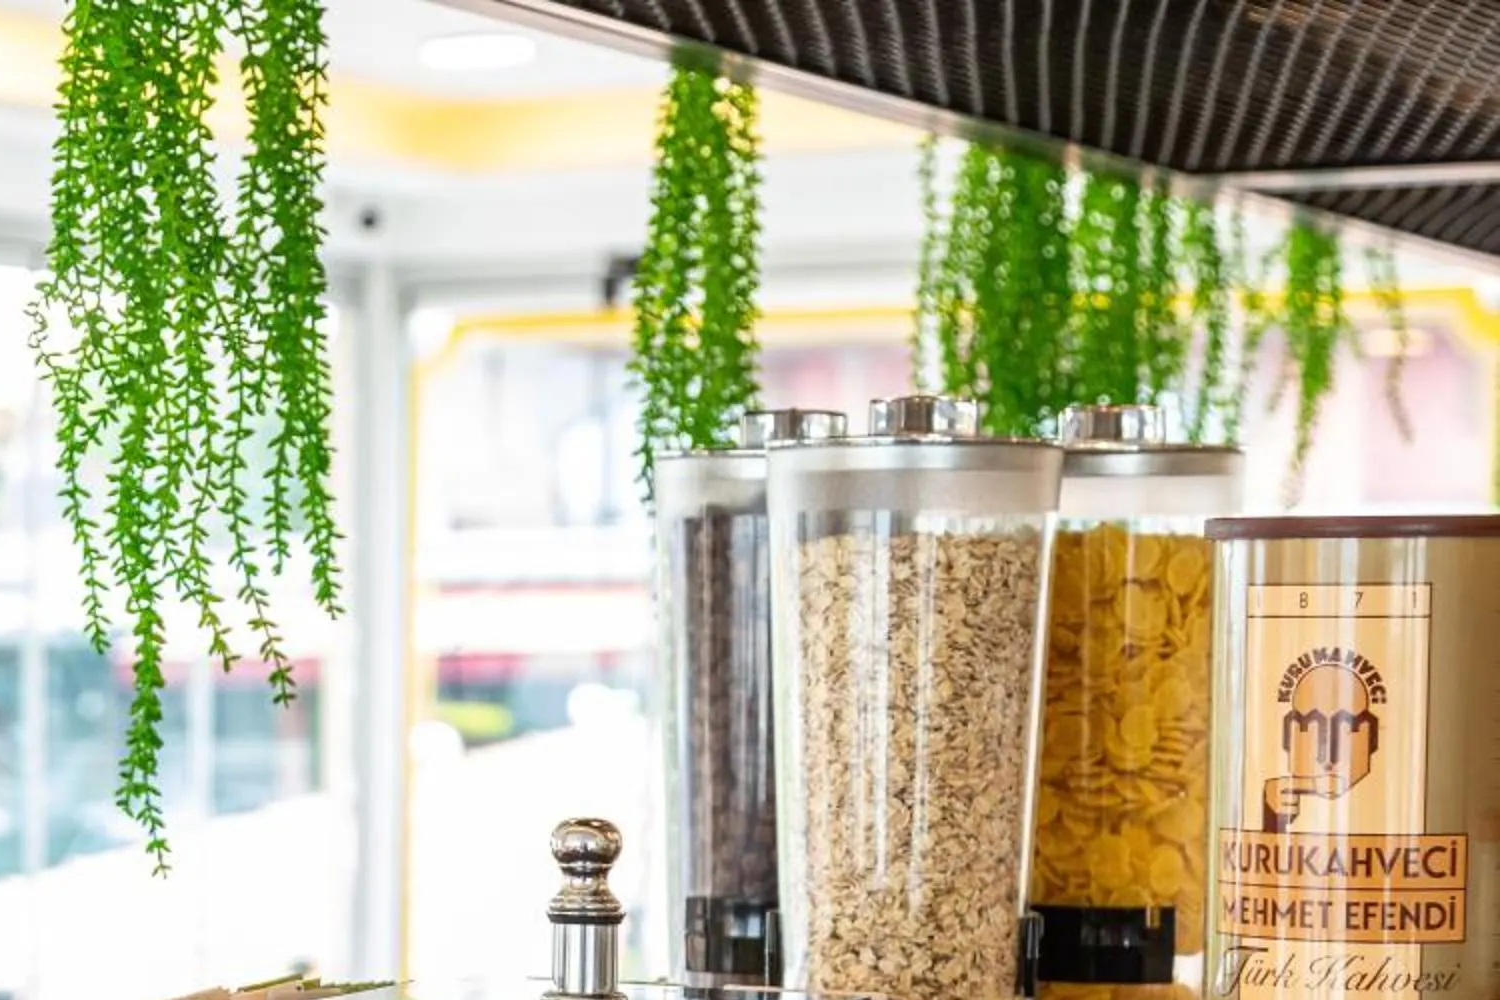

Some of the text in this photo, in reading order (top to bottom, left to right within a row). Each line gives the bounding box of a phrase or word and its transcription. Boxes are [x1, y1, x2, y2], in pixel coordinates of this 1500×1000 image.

[1223, 840, 1458, 879] KURUKAHVECİ
[1223, 896, 1457, 931] MEHMET EFENDİ
[1215, 945, 1462, 997] Türk Kahvesi
